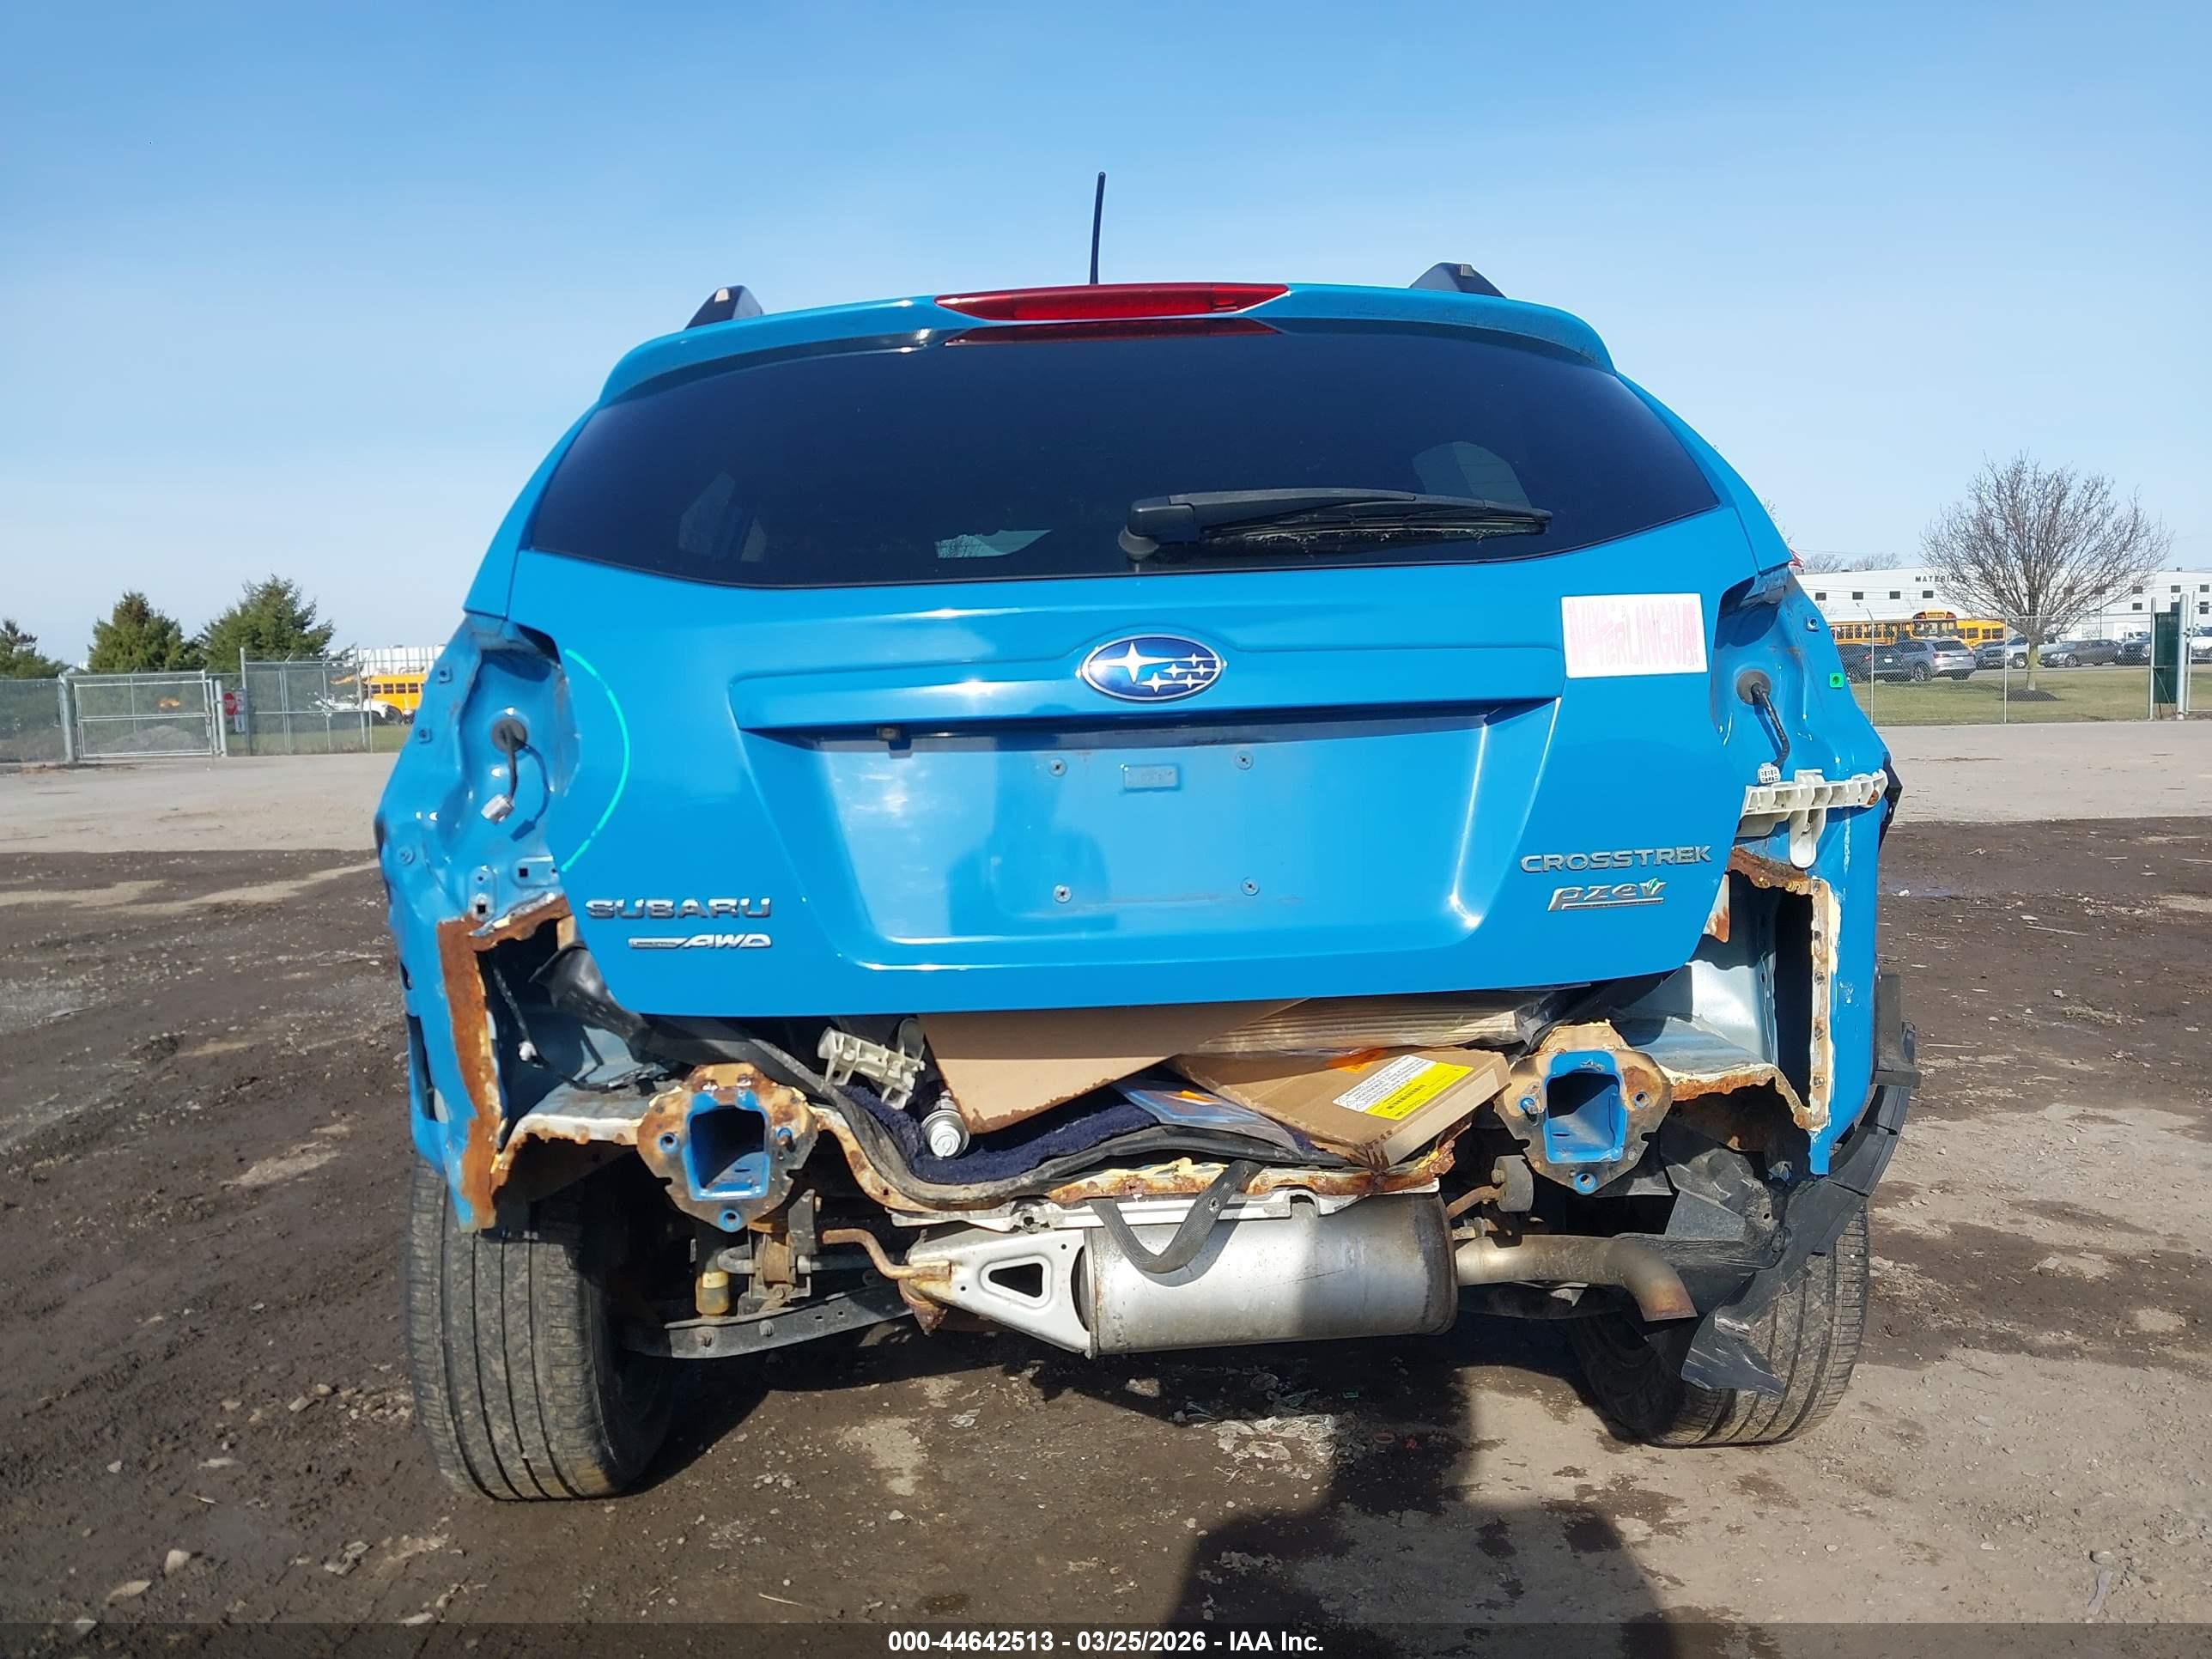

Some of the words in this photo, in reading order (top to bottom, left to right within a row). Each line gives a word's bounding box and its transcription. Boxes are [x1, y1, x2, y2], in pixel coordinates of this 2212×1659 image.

[1521, 845, 1712, 873] CROSSTREK
[585, 897, 771, 919] SUBARU
[684, 933, 772, 948] AWD
